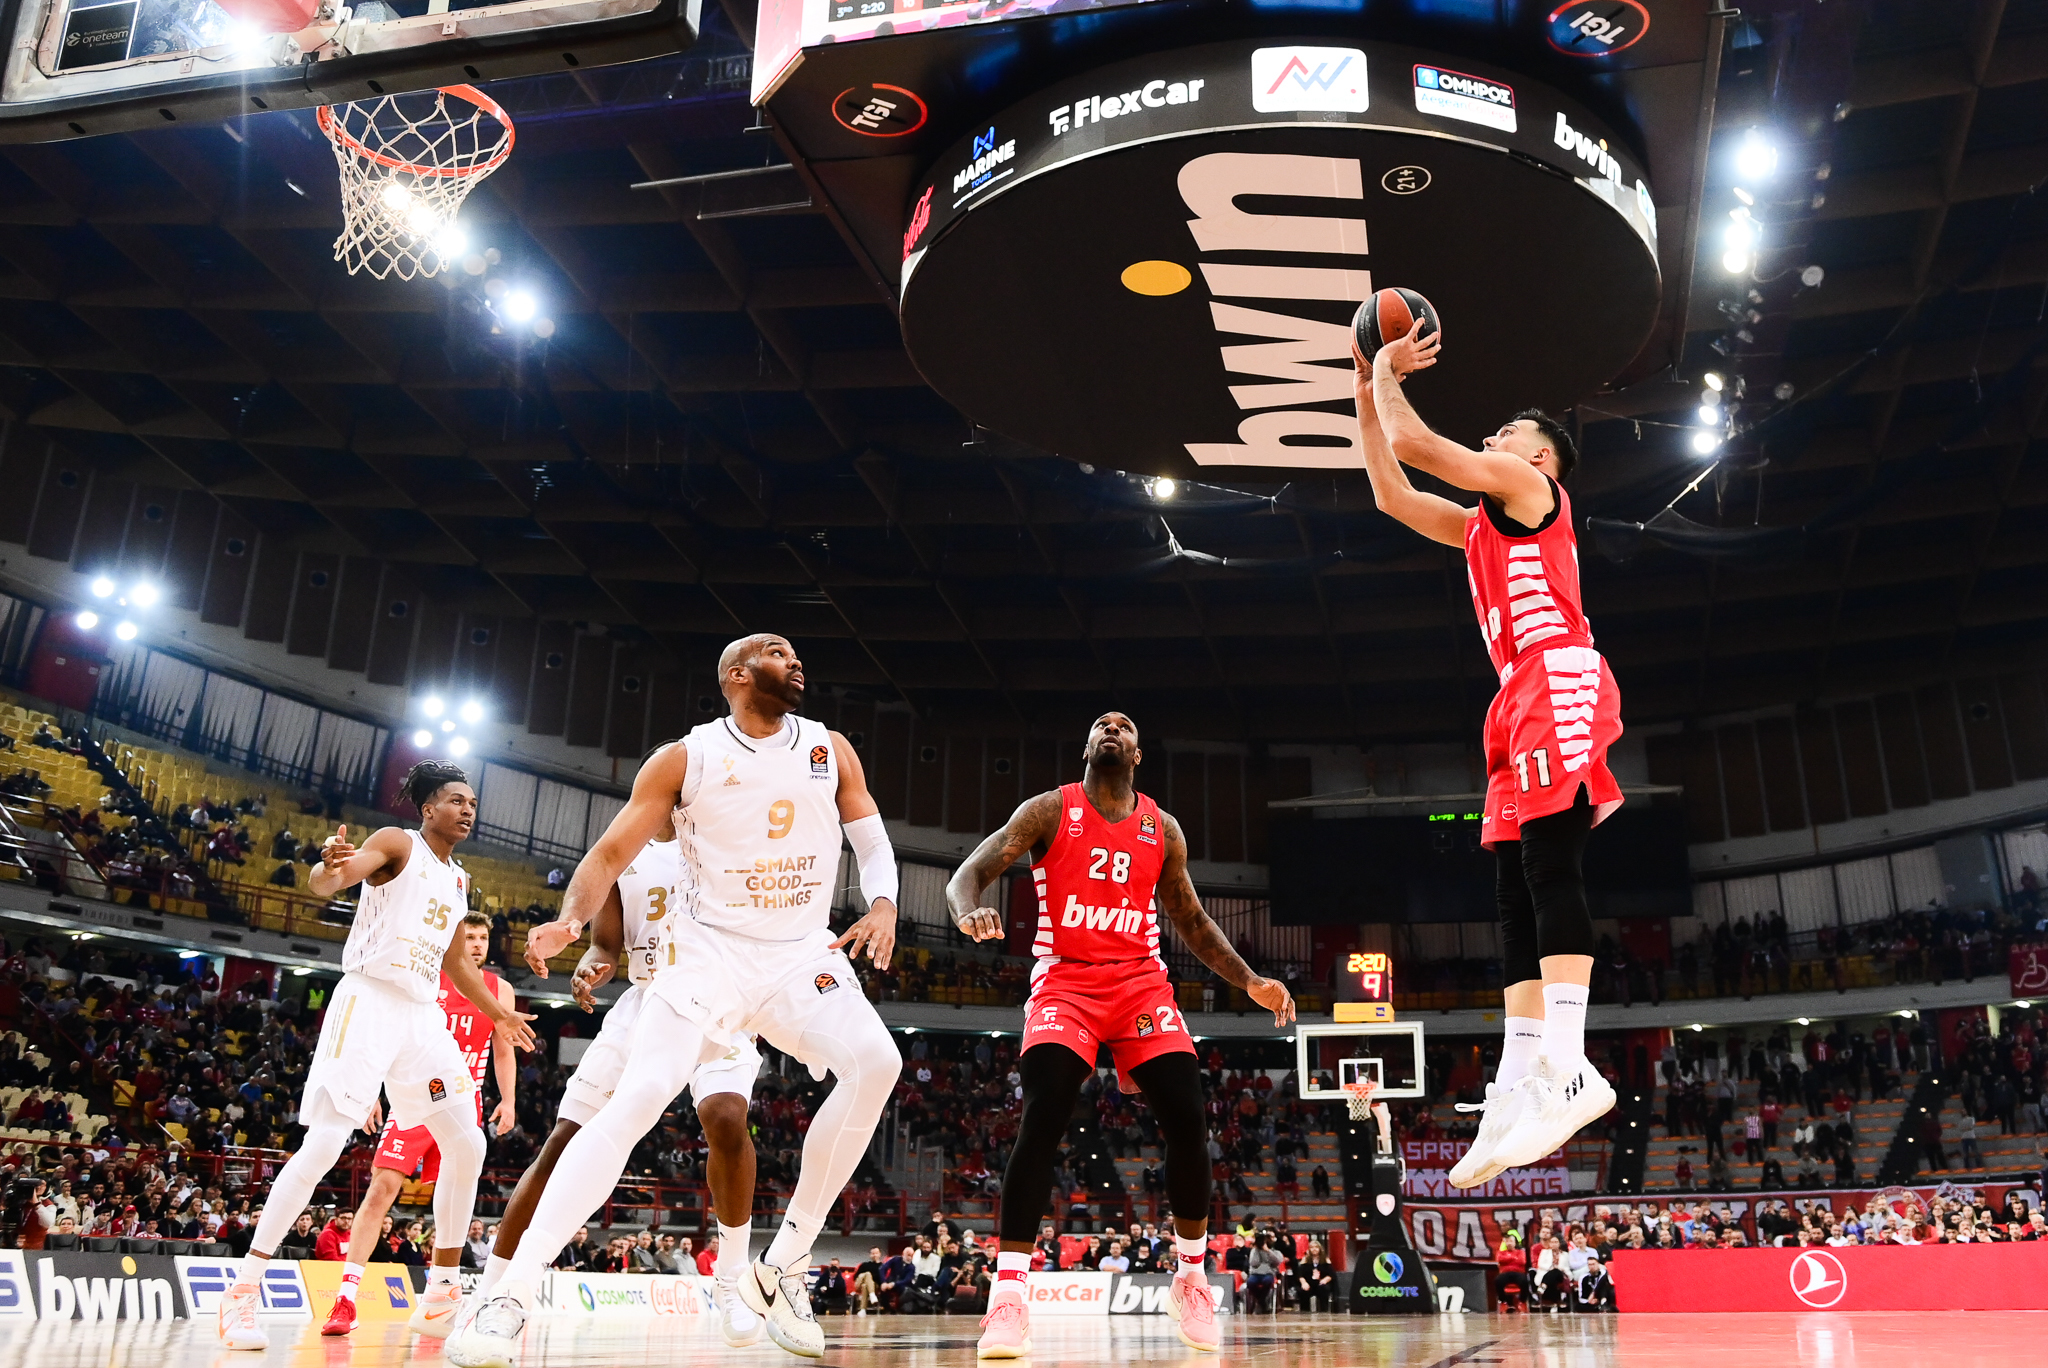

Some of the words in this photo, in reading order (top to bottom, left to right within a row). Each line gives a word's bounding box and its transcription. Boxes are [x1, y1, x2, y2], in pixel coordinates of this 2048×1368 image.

[860, 3, 886, 15] 2:20
[82, 30, 129, 44] oneteam
[1074, 78, 1205, 129] FlexCar
[1554, 111, 1622, 188] bwin
[953, 139, 1016, 193] MARINE
[971, 171, 992, 188] TOURS
[1397, 169, 1416, 191] 21+
[1121, 152, 1372, 469] bwin
[1516, 748, 1552, 793] 11
[767, 799, 795, 839] 9
[754, 855, 817, 873] SMART
[1088, 846, 1132, 885] 28
[746, 874, 802, 891] GOOD
[645, 886, 676, 921] 3
[750, 889, 812, 909] THINGS
[422, 897, 452, 931] 35
[1060, 894, 1144, 935] bwin
[409, 946, 436, 969] GOOD
[1347, 953, 1387, 973] 2:20
[409, 959, 438, 984] THINGS
[846, 977, 861, 990] 9
[1363, 972, 1382, 999] 9
[449, 1013, 474, 1036] 14
[1031, 1022, 1065, 1034] FlexCar
[454, 1074, 474, 1094] 35
[382, 1150, 406, 1161] FlexCar
[38, 1255, 175, 1320] bwin
[596, 1289, 647, 1306] COSMOTE
[1359, 1286, 1420, 1298] COSMOTE
